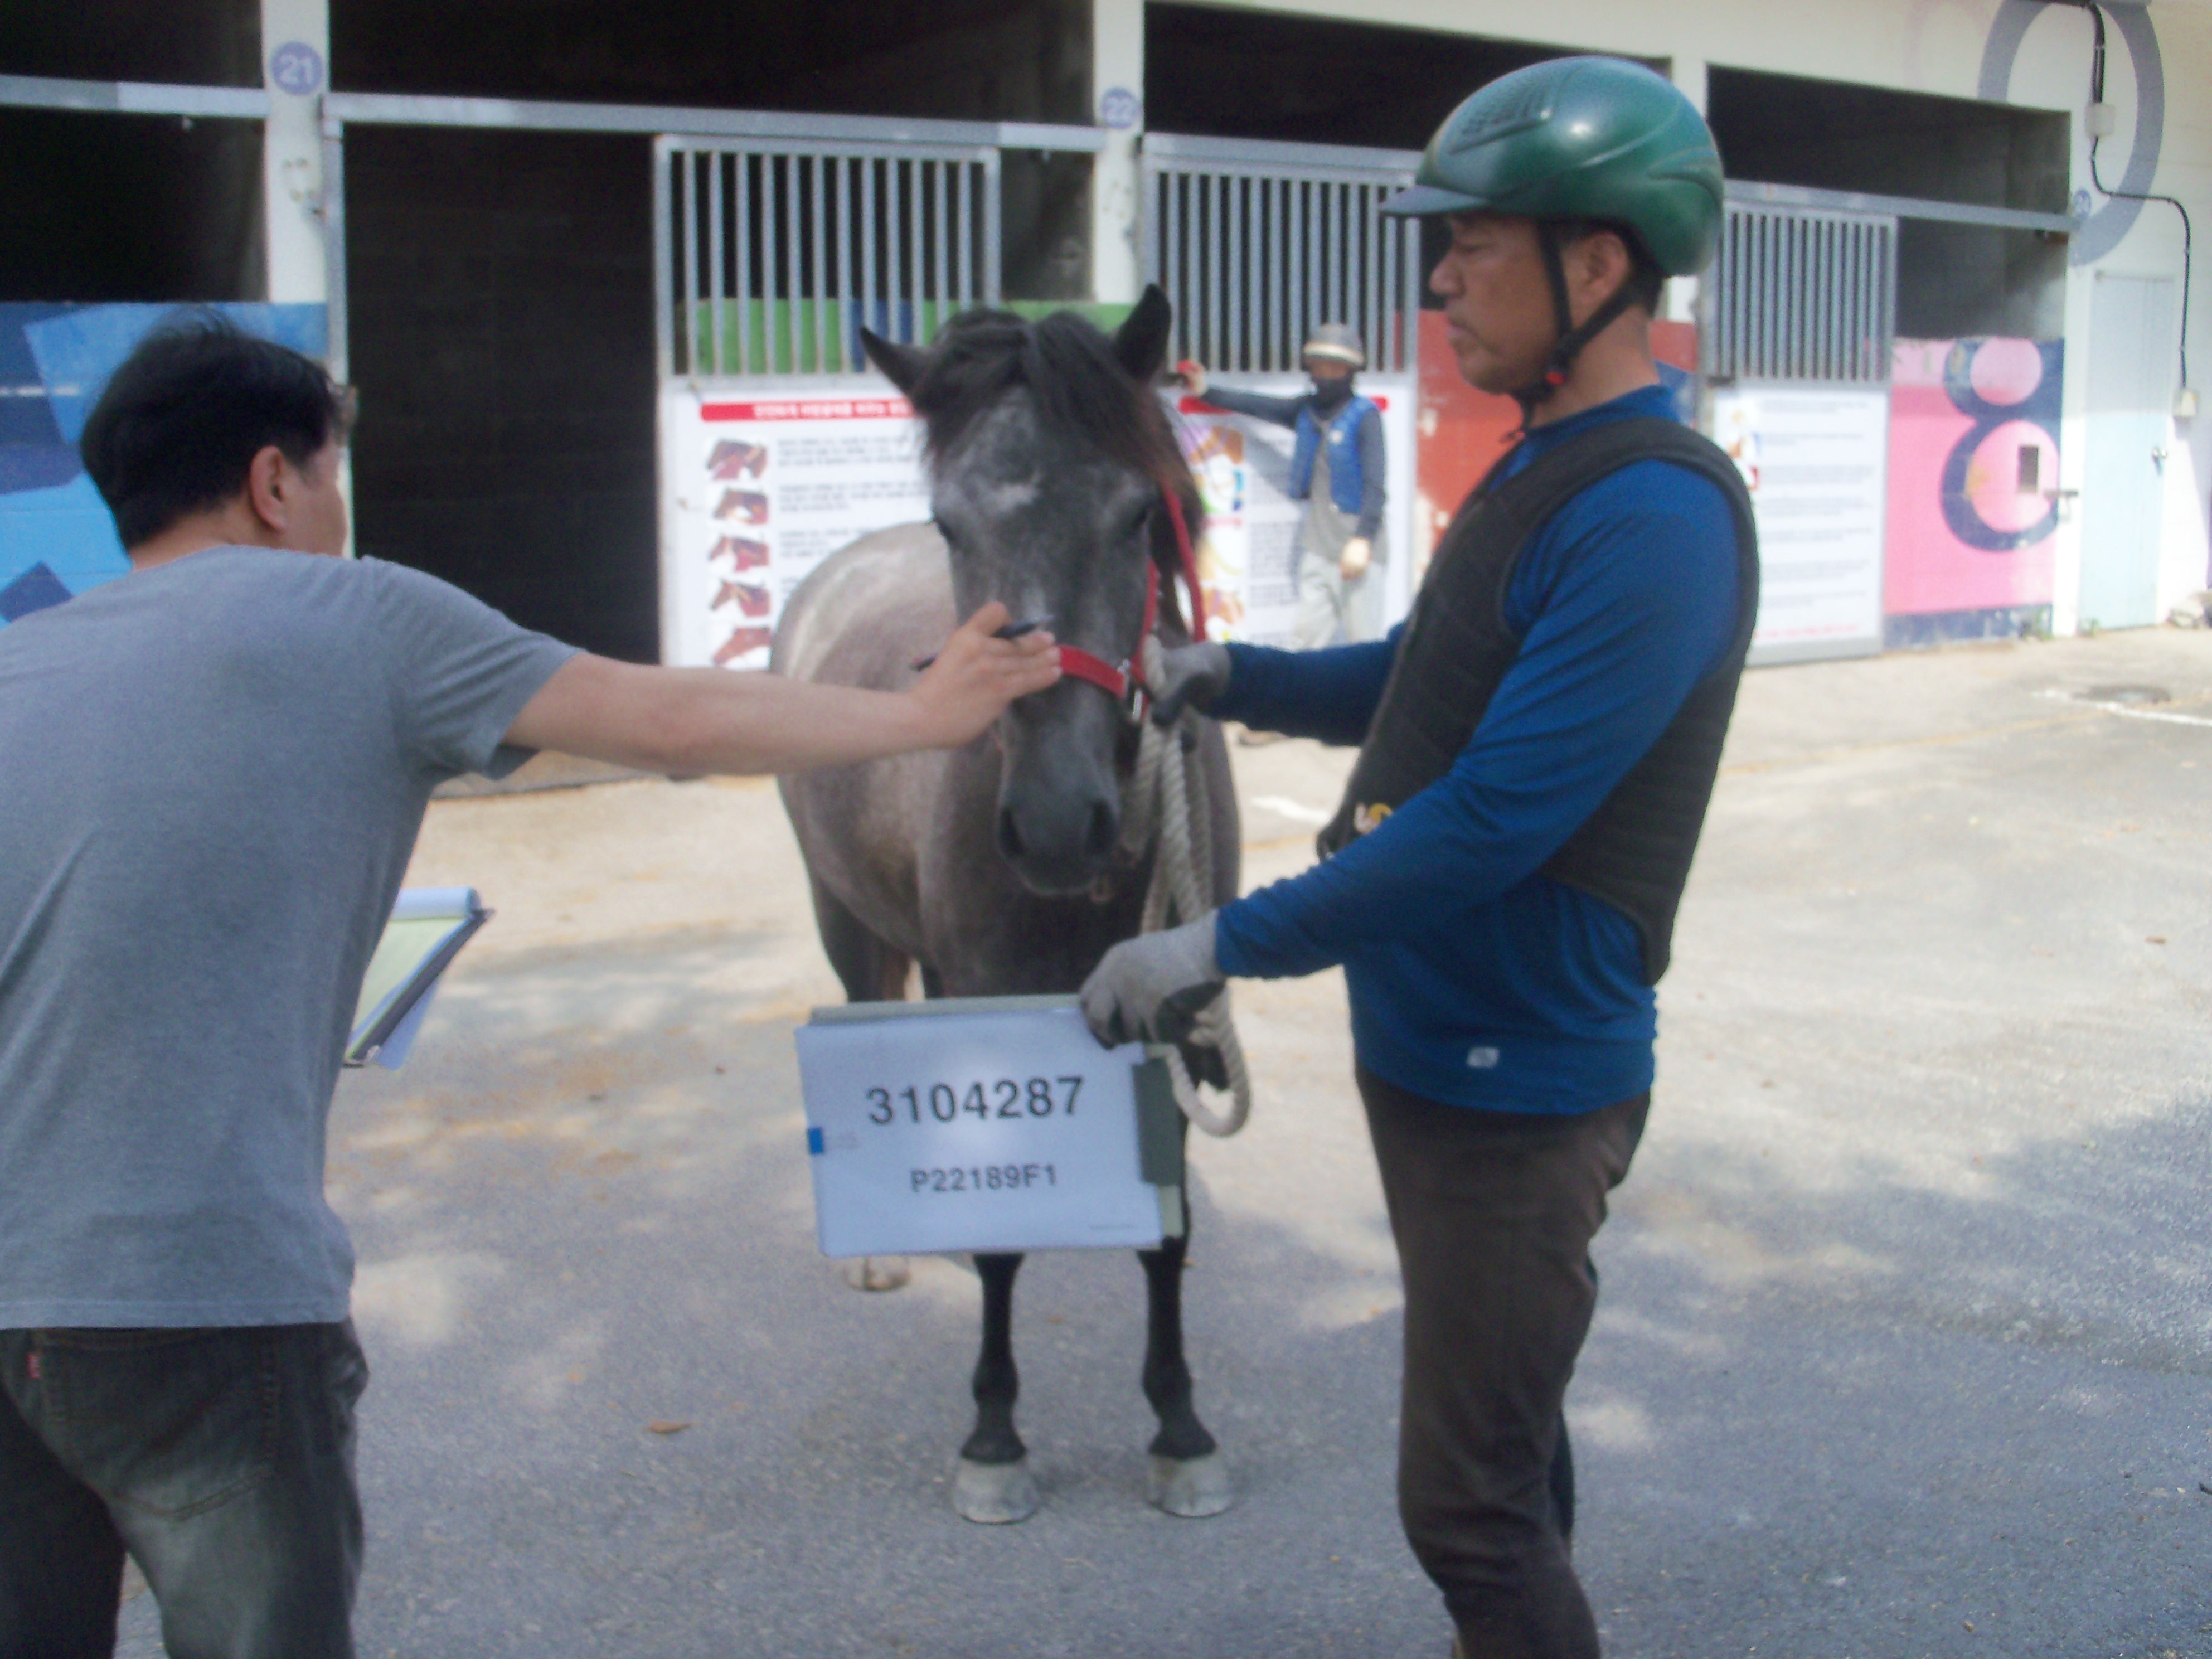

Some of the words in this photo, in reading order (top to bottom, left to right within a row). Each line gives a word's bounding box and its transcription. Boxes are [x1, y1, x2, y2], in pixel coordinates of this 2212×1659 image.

[279, 55, 313, 84] 21
[866, 1075, 1084, 1125] 3104287
[910, 1162, 1056, 1192] P22189F1
